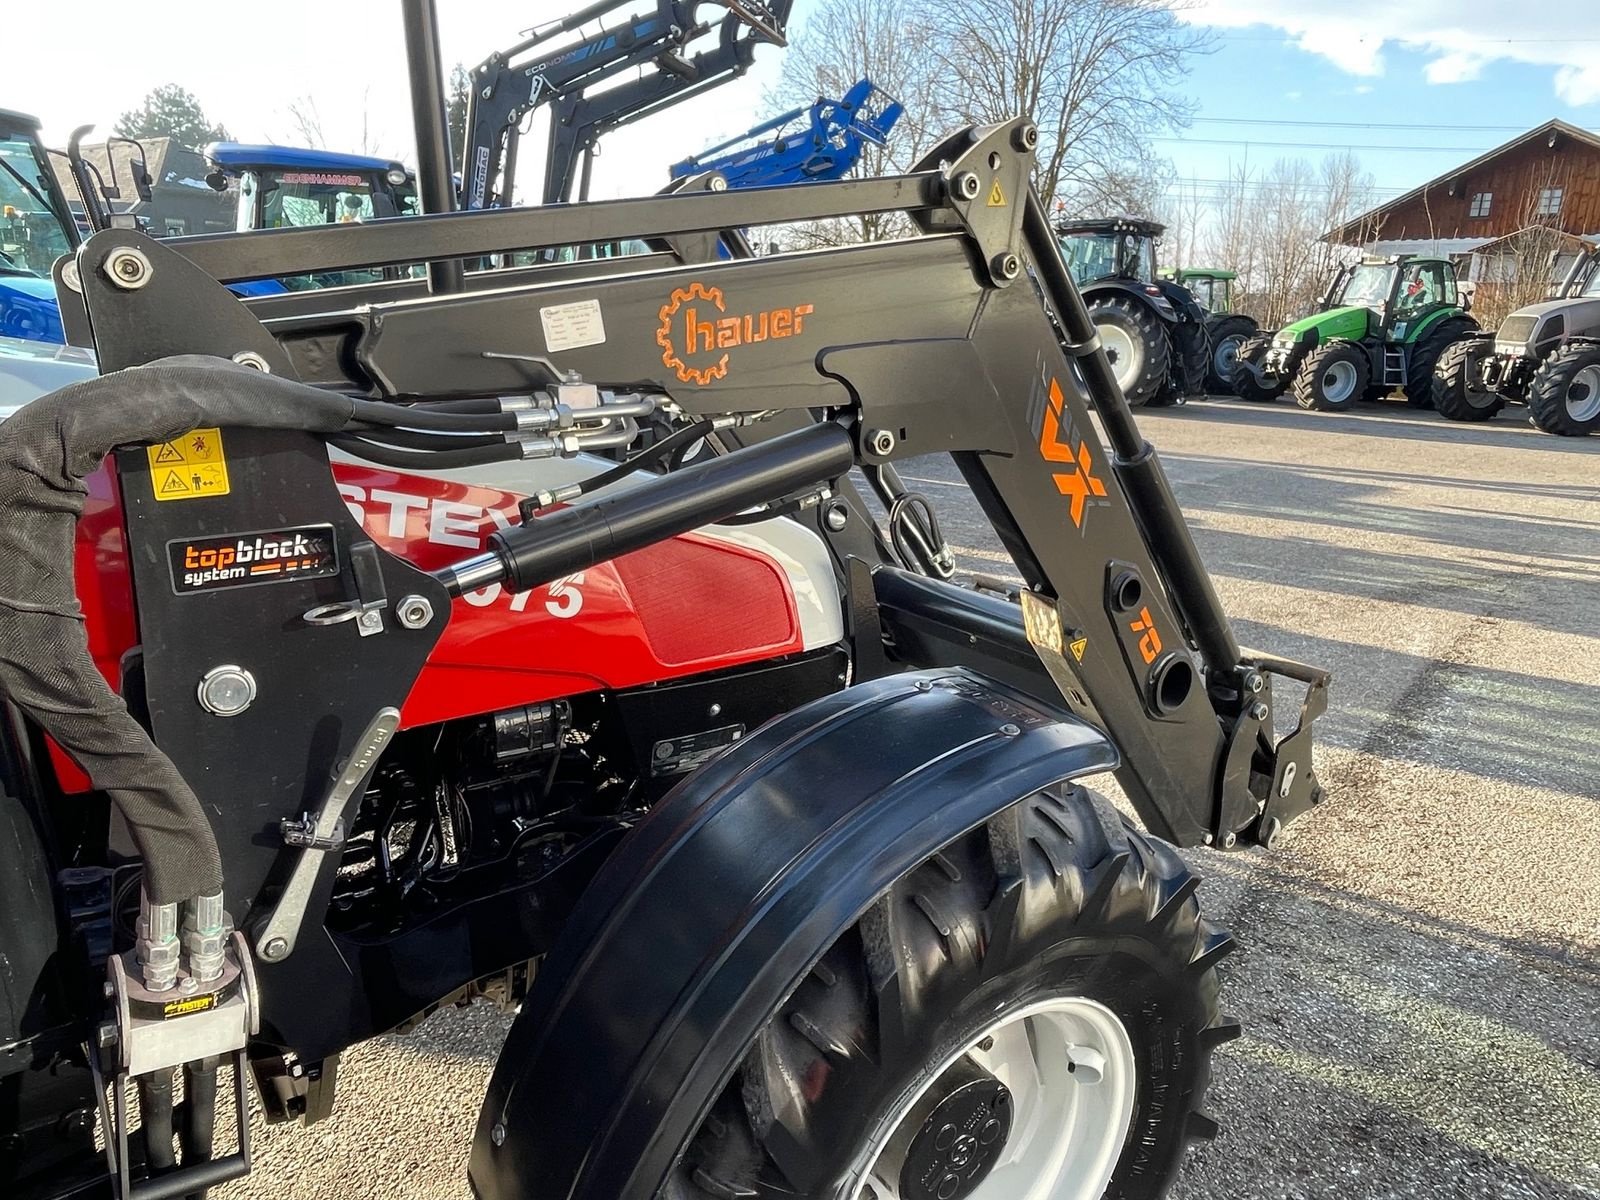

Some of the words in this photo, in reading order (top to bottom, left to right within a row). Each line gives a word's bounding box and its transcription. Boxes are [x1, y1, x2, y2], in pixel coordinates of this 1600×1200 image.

[525, 51, 577, 77] ECONOMY
[477, 150, 489, 199] HYDRAC
[686, 304, 814, 355] hauer
[184, 566, 246, 586] system
[1130, 606, 1162, 664] 70
